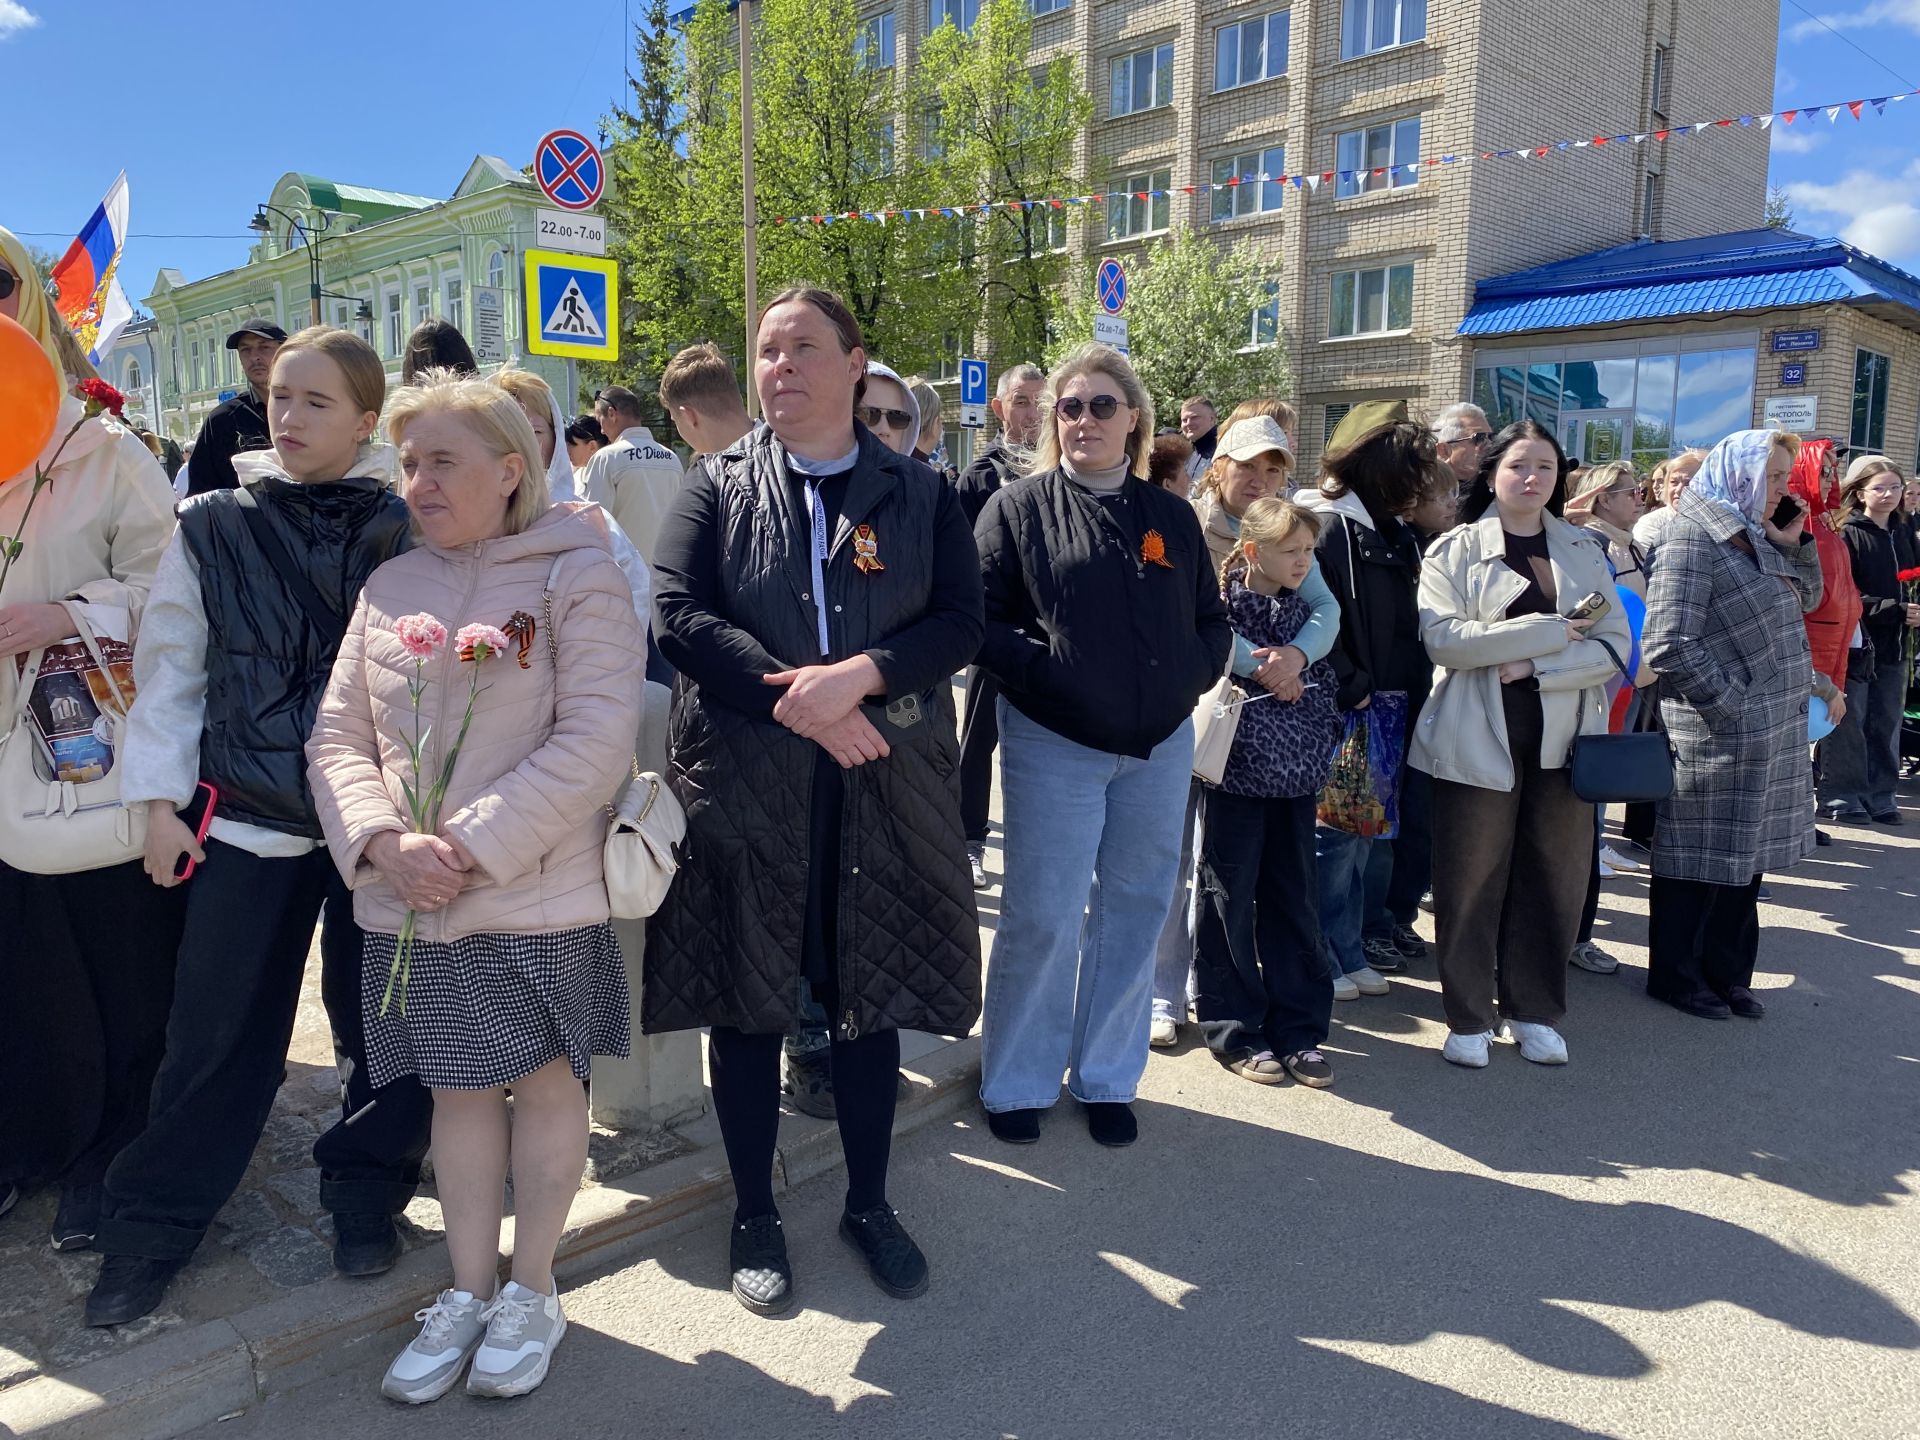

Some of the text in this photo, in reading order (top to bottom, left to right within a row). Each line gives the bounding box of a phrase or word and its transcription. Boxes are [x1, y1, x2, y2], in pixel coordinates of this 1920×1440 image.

[1786, 369, 1800, 379] 32
[968, 365, 983, 400] P
[623, 446, 673, 461] FC Diesel
